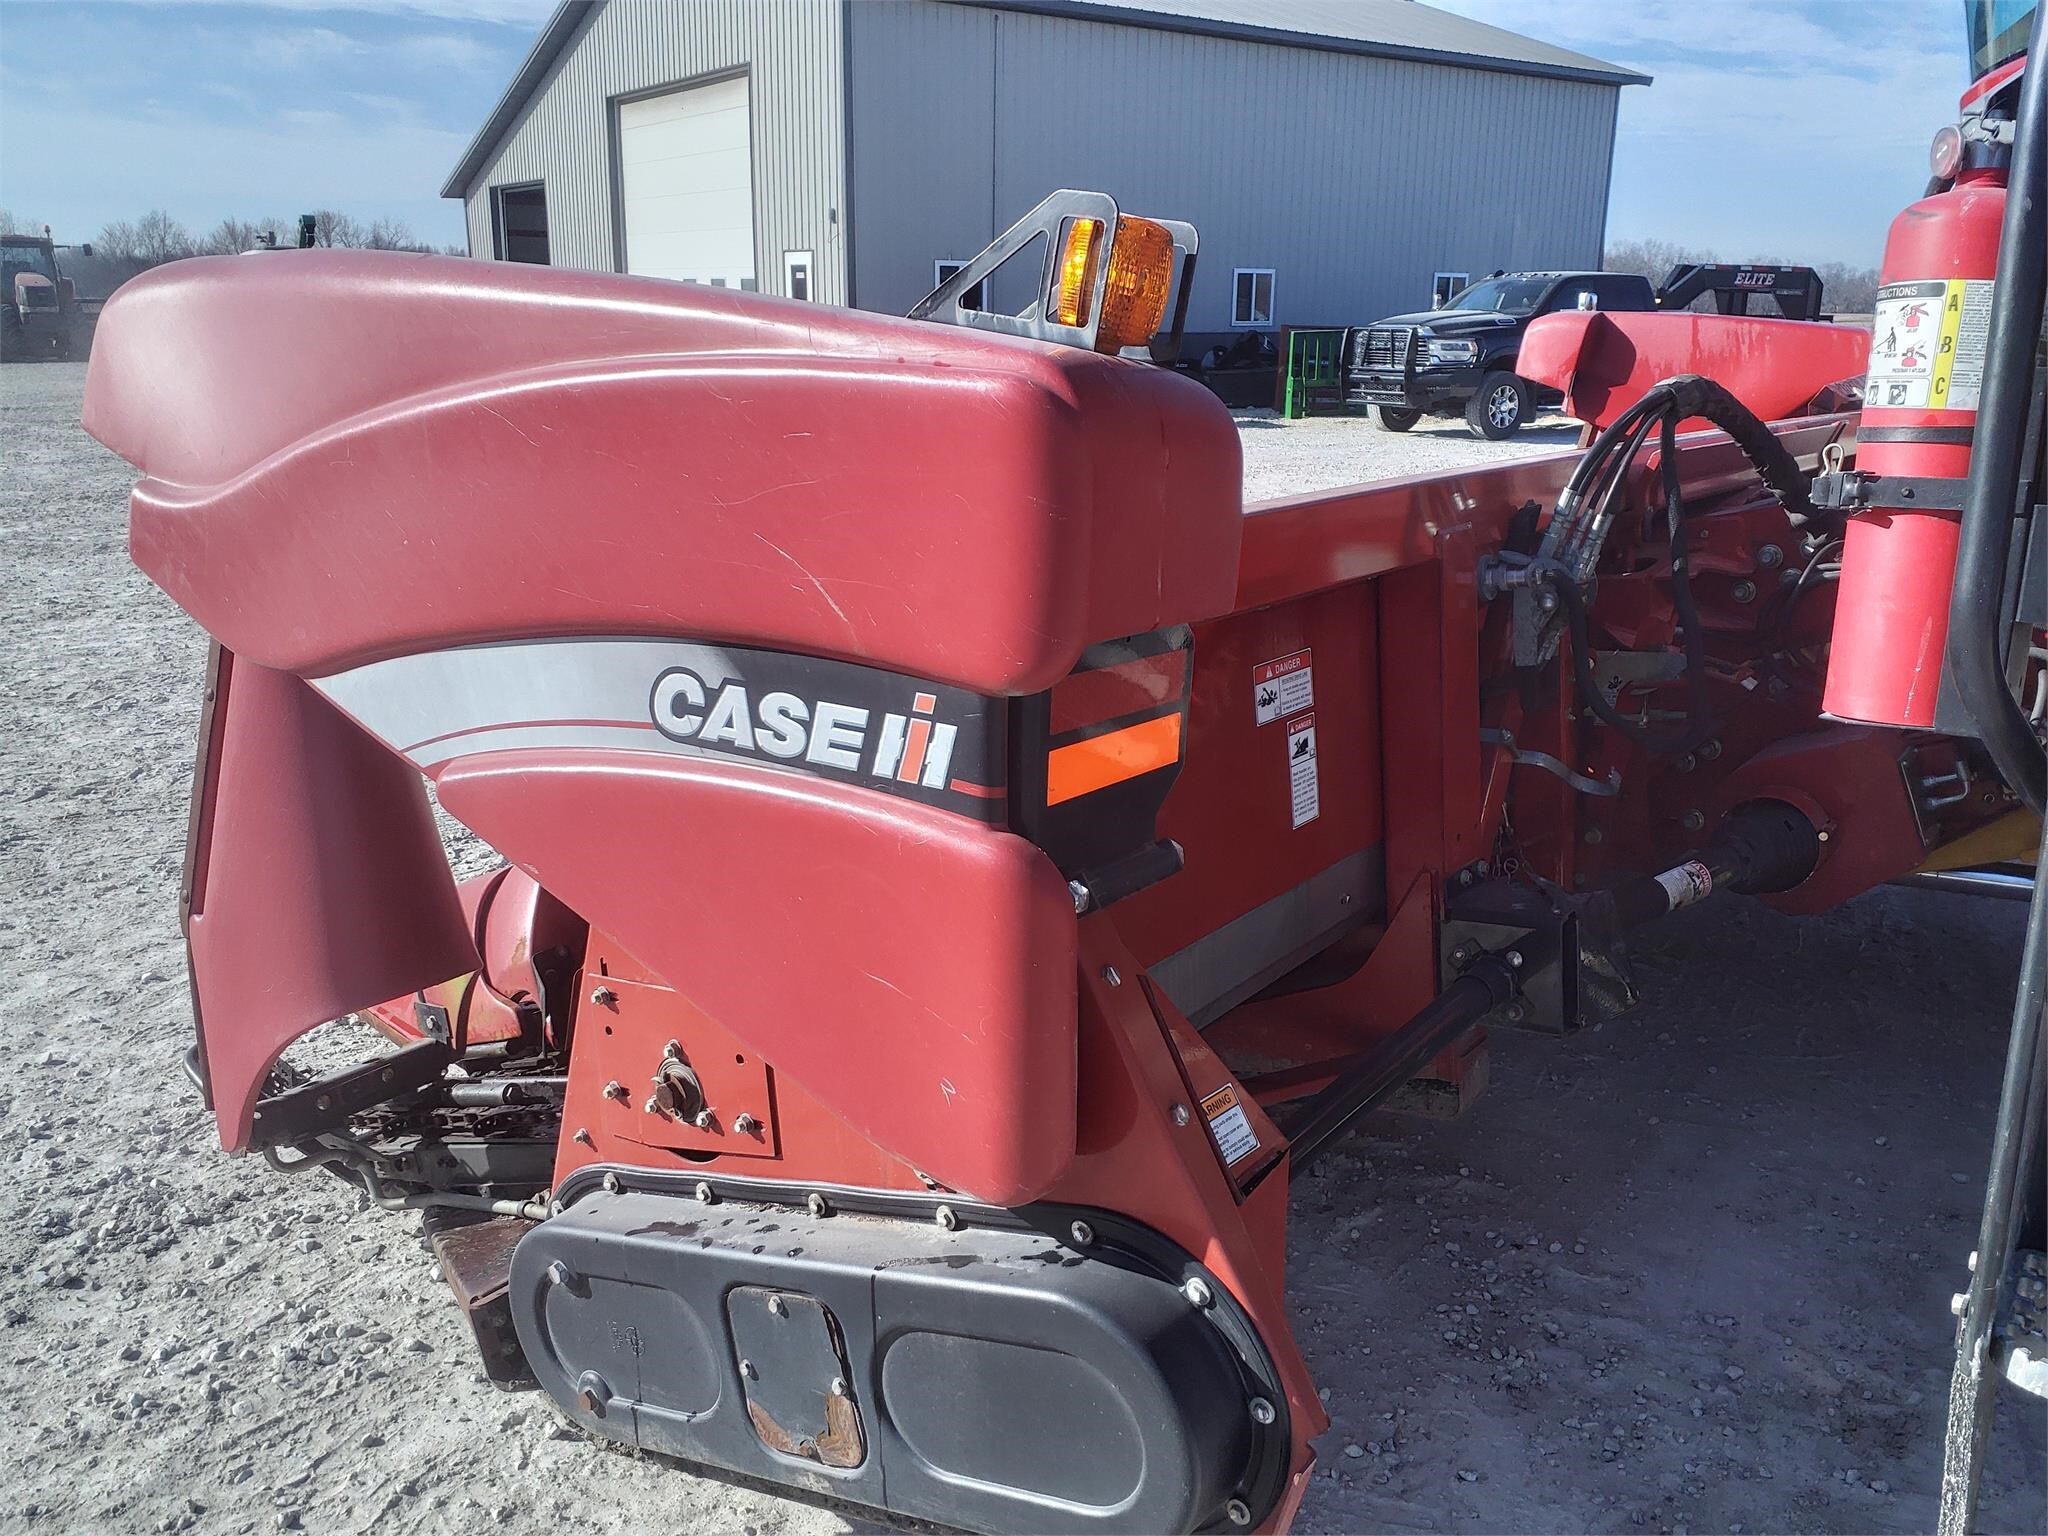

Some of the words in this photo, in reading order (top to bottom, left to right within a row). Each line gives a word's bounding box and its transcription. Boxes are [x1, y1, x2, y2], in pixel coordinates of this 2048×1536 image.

[1734, 272, 1776, 285] ELITE
[1948, 293, 1958, 312] A
[1941, 336, 1952, 353] B
[1935, 376, 1945, 395] C
[1275, 657, 1301, 674] DANGER
[653, 672, 870, 772] CASE
